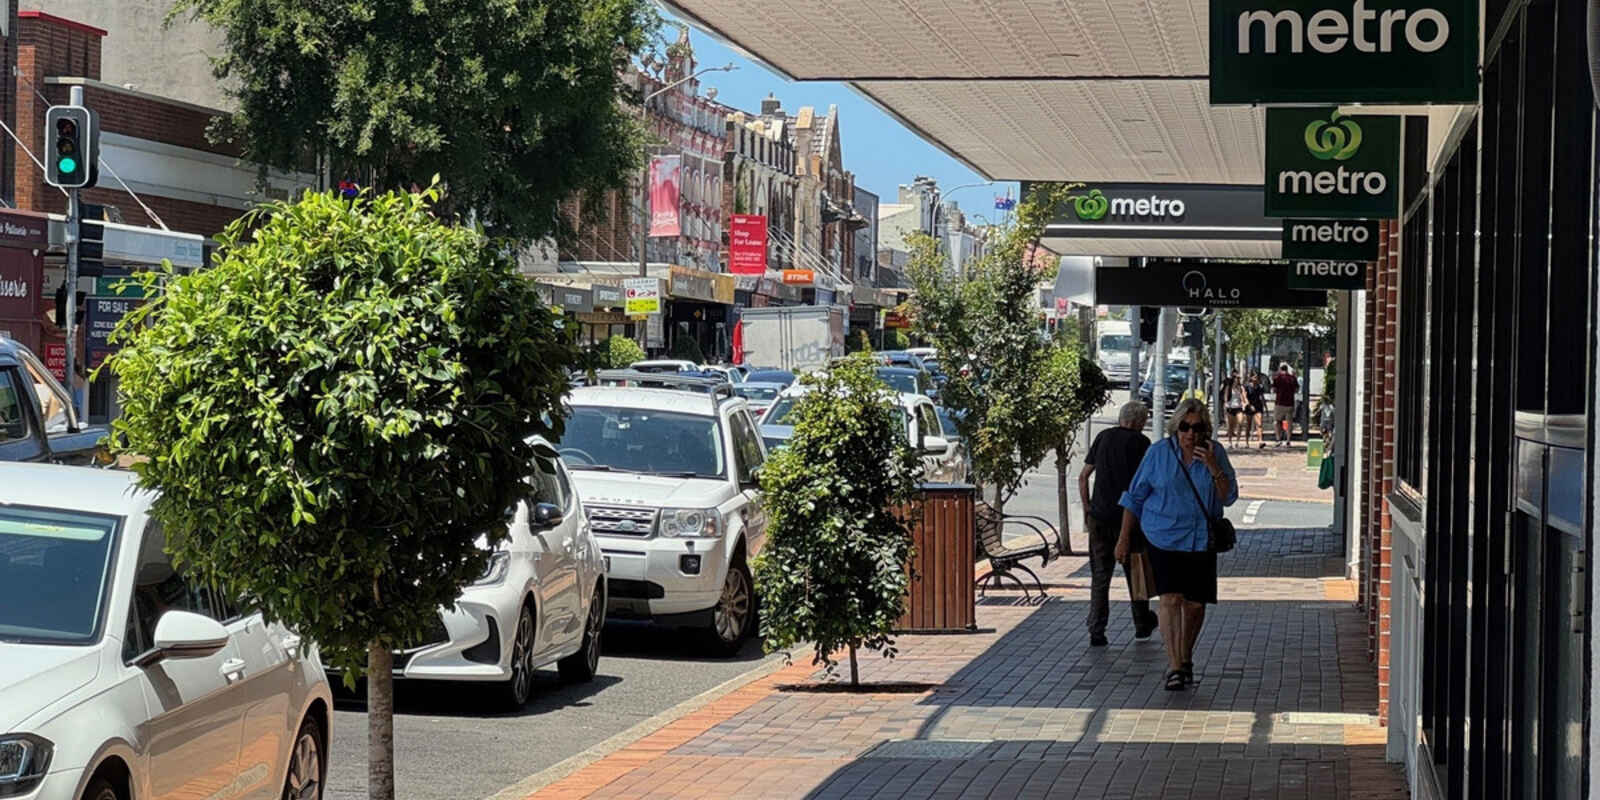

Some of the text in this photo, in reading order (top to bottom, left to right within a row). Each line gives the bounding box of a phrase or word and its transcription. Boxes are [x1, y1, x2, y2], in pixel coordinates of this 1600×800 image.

[1238, 0, 1450, 53] metro
[1278, 165, 1387, 195] metro
[1110, 194, 1185, 216] metro
[1292, 219, 1369, 244] metro
[786, 273, 811, 281] STIHL
[1296, 259, 1359, 277] metro
[1189, 288, 1241, 298] HALO
[97, 300, 129, 313] FOR SALE
